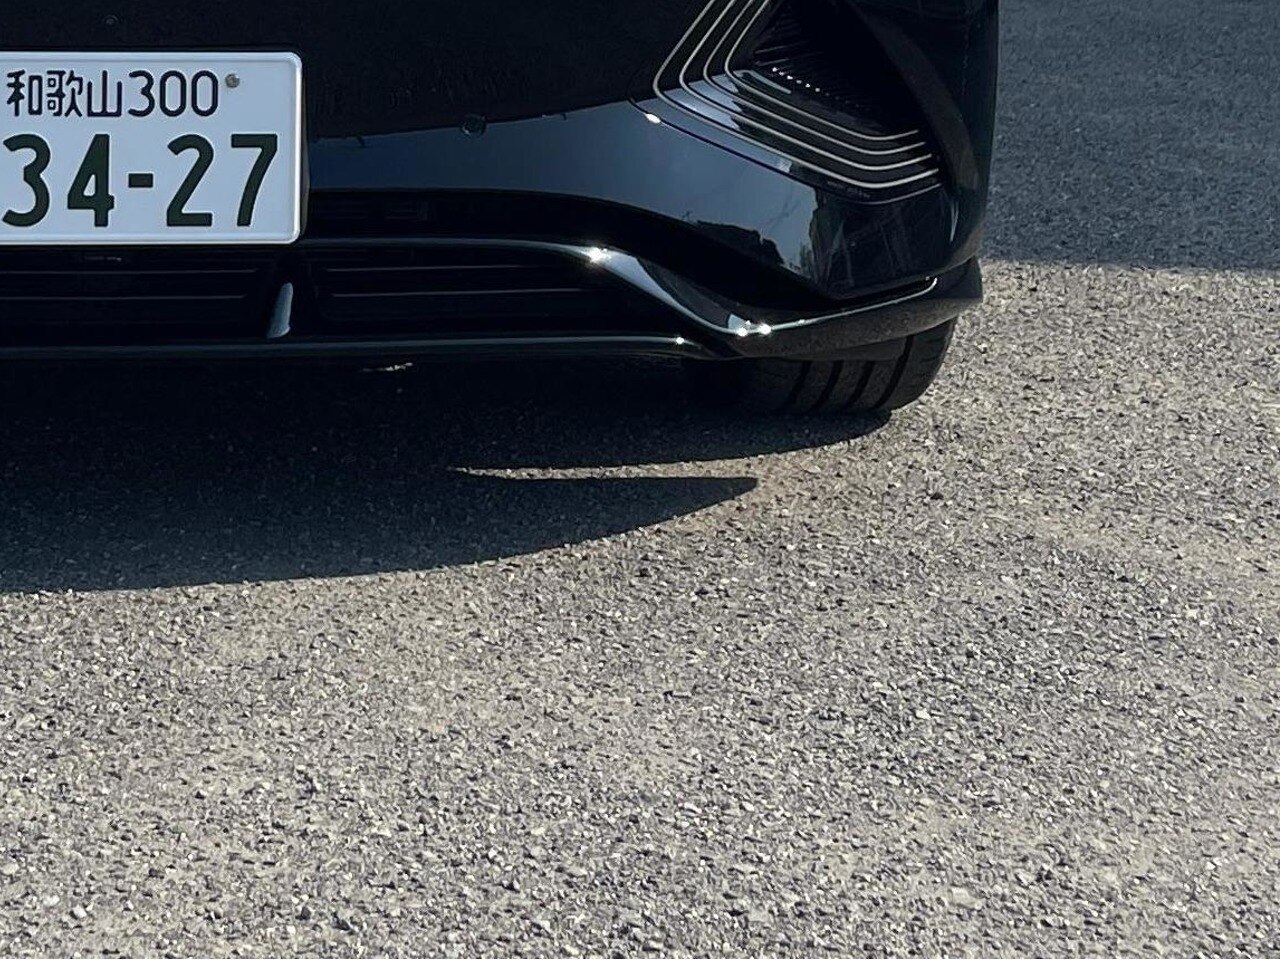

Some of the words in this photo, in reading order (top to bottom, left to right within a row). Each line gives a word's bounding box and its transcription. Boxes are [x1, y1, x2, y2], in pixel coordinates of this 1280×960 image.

[6, 69, 219, 118] 和歌山300
[1, 133, 279, 228] 34-27
